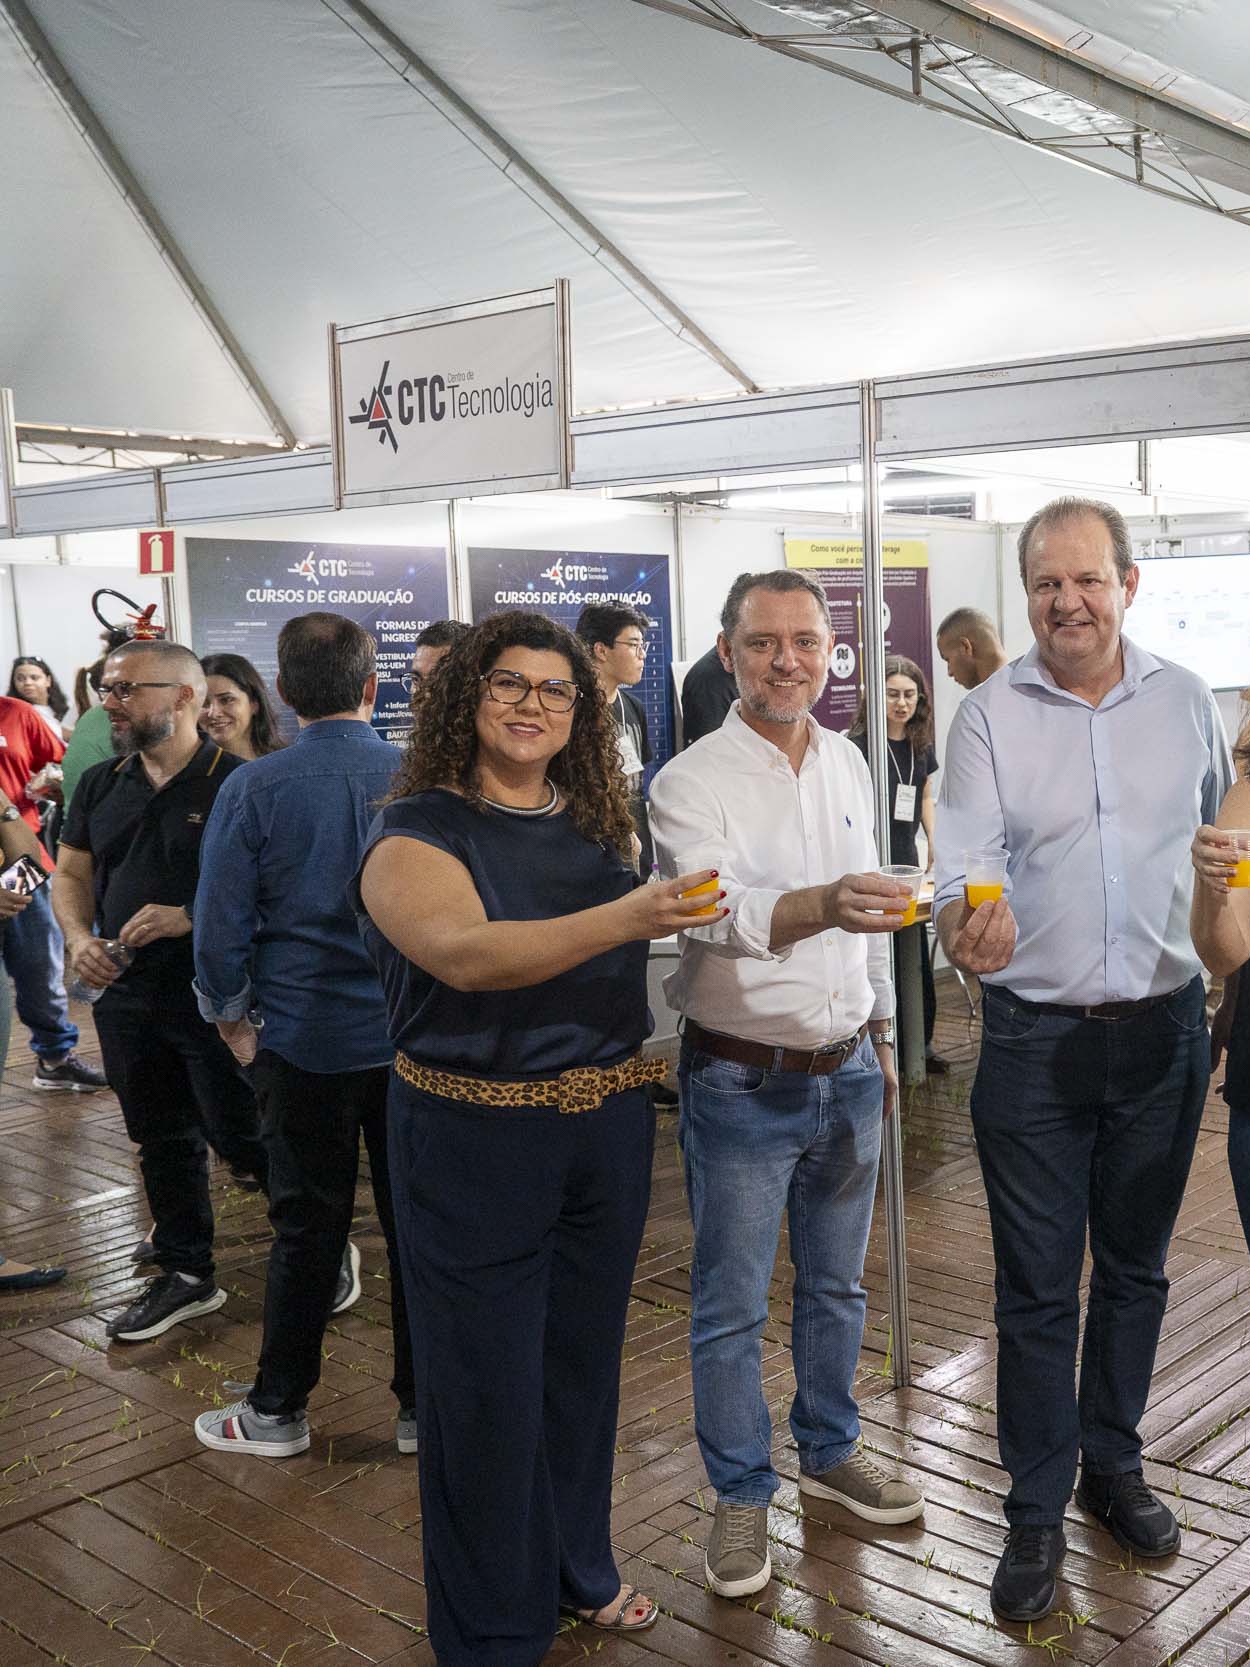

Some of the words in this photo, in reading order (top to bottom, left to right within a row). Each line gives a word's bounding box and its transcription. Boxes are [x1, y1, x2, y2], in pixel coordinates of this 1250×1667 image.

[398, 374, 446, 426] CTC
[447, 372, 553, 419] Tecnologia
[319, 559, 348, 577] CTC
[565, 565, 588, 581] CTC
[246, 588, 304, 604] CURSOS
[307, 590, 326, 604] DE
[328, 588, 414, 606] GRADUAÇÃO
[494, 591, 541, 604] CURSOS
[543, 592, 557, 605] DE
[376, 621, 416, 630] FORMAS
[382, 633, 420, 642] INGRES
